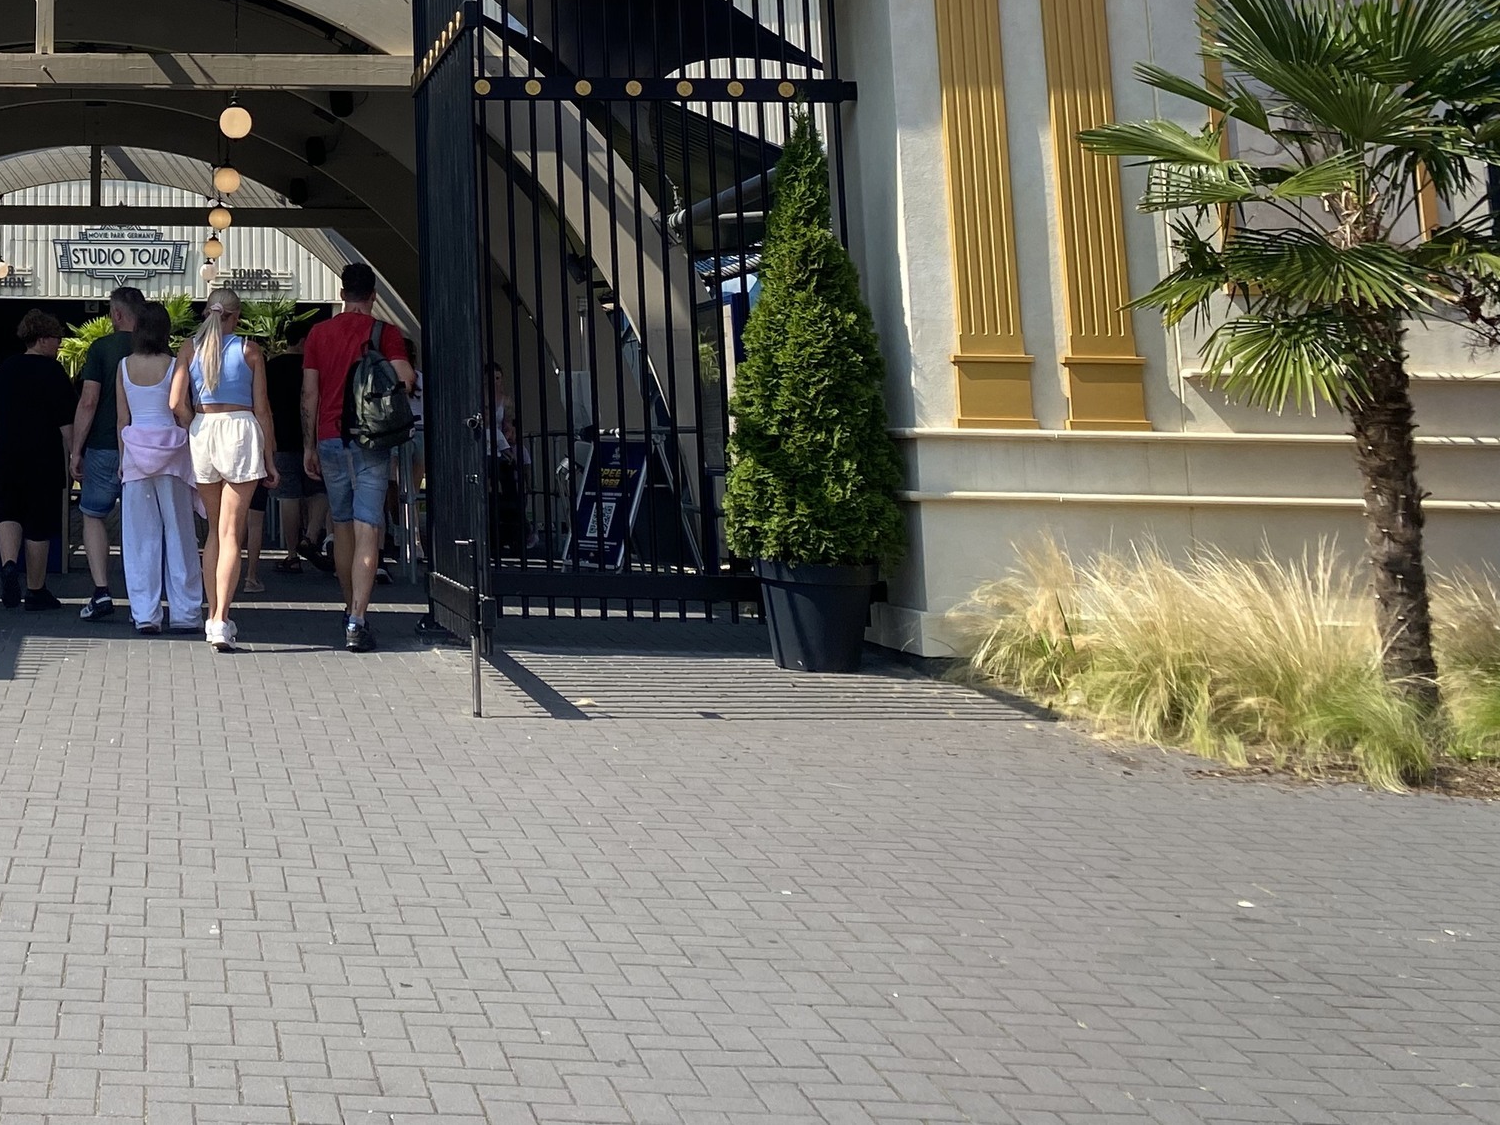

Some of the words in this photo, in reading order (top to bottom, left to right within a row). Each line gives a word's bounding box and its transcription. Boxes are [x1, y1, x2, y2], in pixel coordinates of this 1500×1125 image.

[72, 248, 125, 266] STUDIO
[130, 248, 170, 266] TOUR
[231, 268, 272, 279] TOURS
